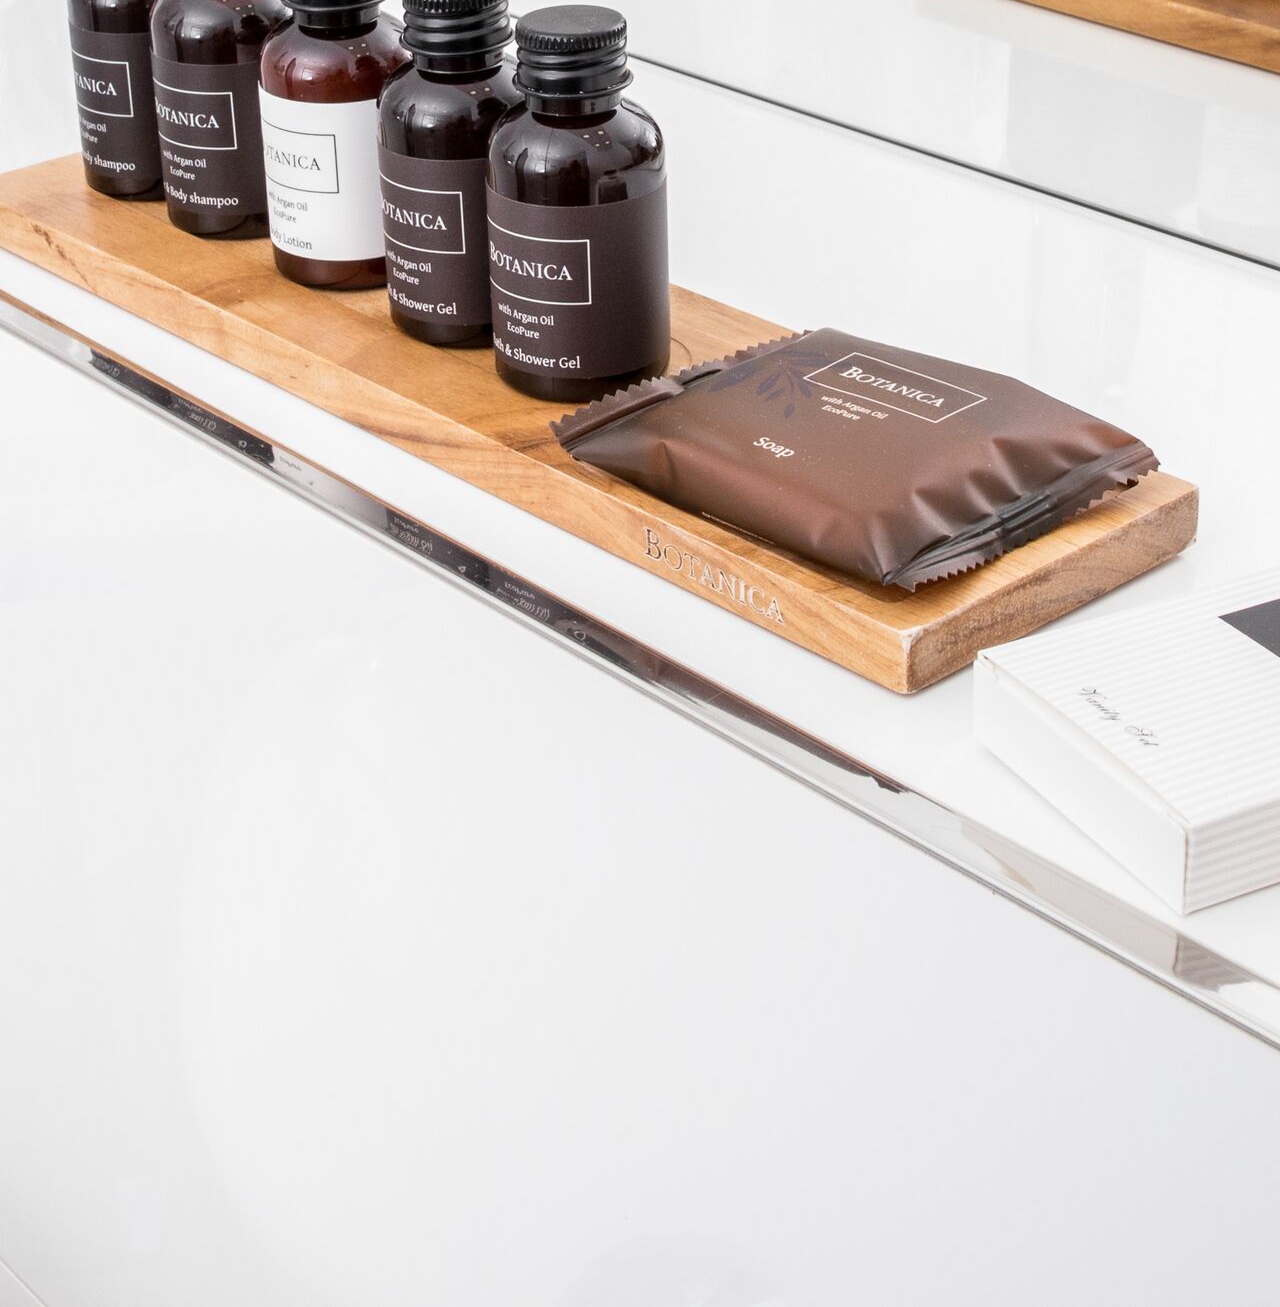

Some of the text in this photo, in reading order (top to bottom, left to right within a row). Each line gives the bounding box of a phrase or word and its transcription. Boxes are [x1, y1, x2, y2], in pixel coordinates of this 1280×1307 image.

[94, 155, 136, 173] shampoo
[173, 153, 194, 167] Argan
[194, 158, 207, 169] Oil
[189, 192, 239, 209] shampoo
[296, 202, 308, 212] Oil
[282, 233, 313, 250] Lotion
[396, 255, 418, 271] Argan
[418, 262, 432, 273] Oil
[489, 240, 573, 282] BOTANICA
[399, 292, 434, 313] Shower
[436, 302, 457, 315] Gel
[497, 302, 555, 326] with Argan Oil
[507, 321, 540, 340] EcoPure
[504, 343, 513, 357] &
[513, 348, 557, 369] Shower
[558, 355, 581, 369] Gel
[839, 366, 945, 408] BOTANICA
[820, 395, 889, 420] with Argan Oil
[821, 404, 861, 421] EcoPure
[643, 527, 784, 625] BOTANICA
